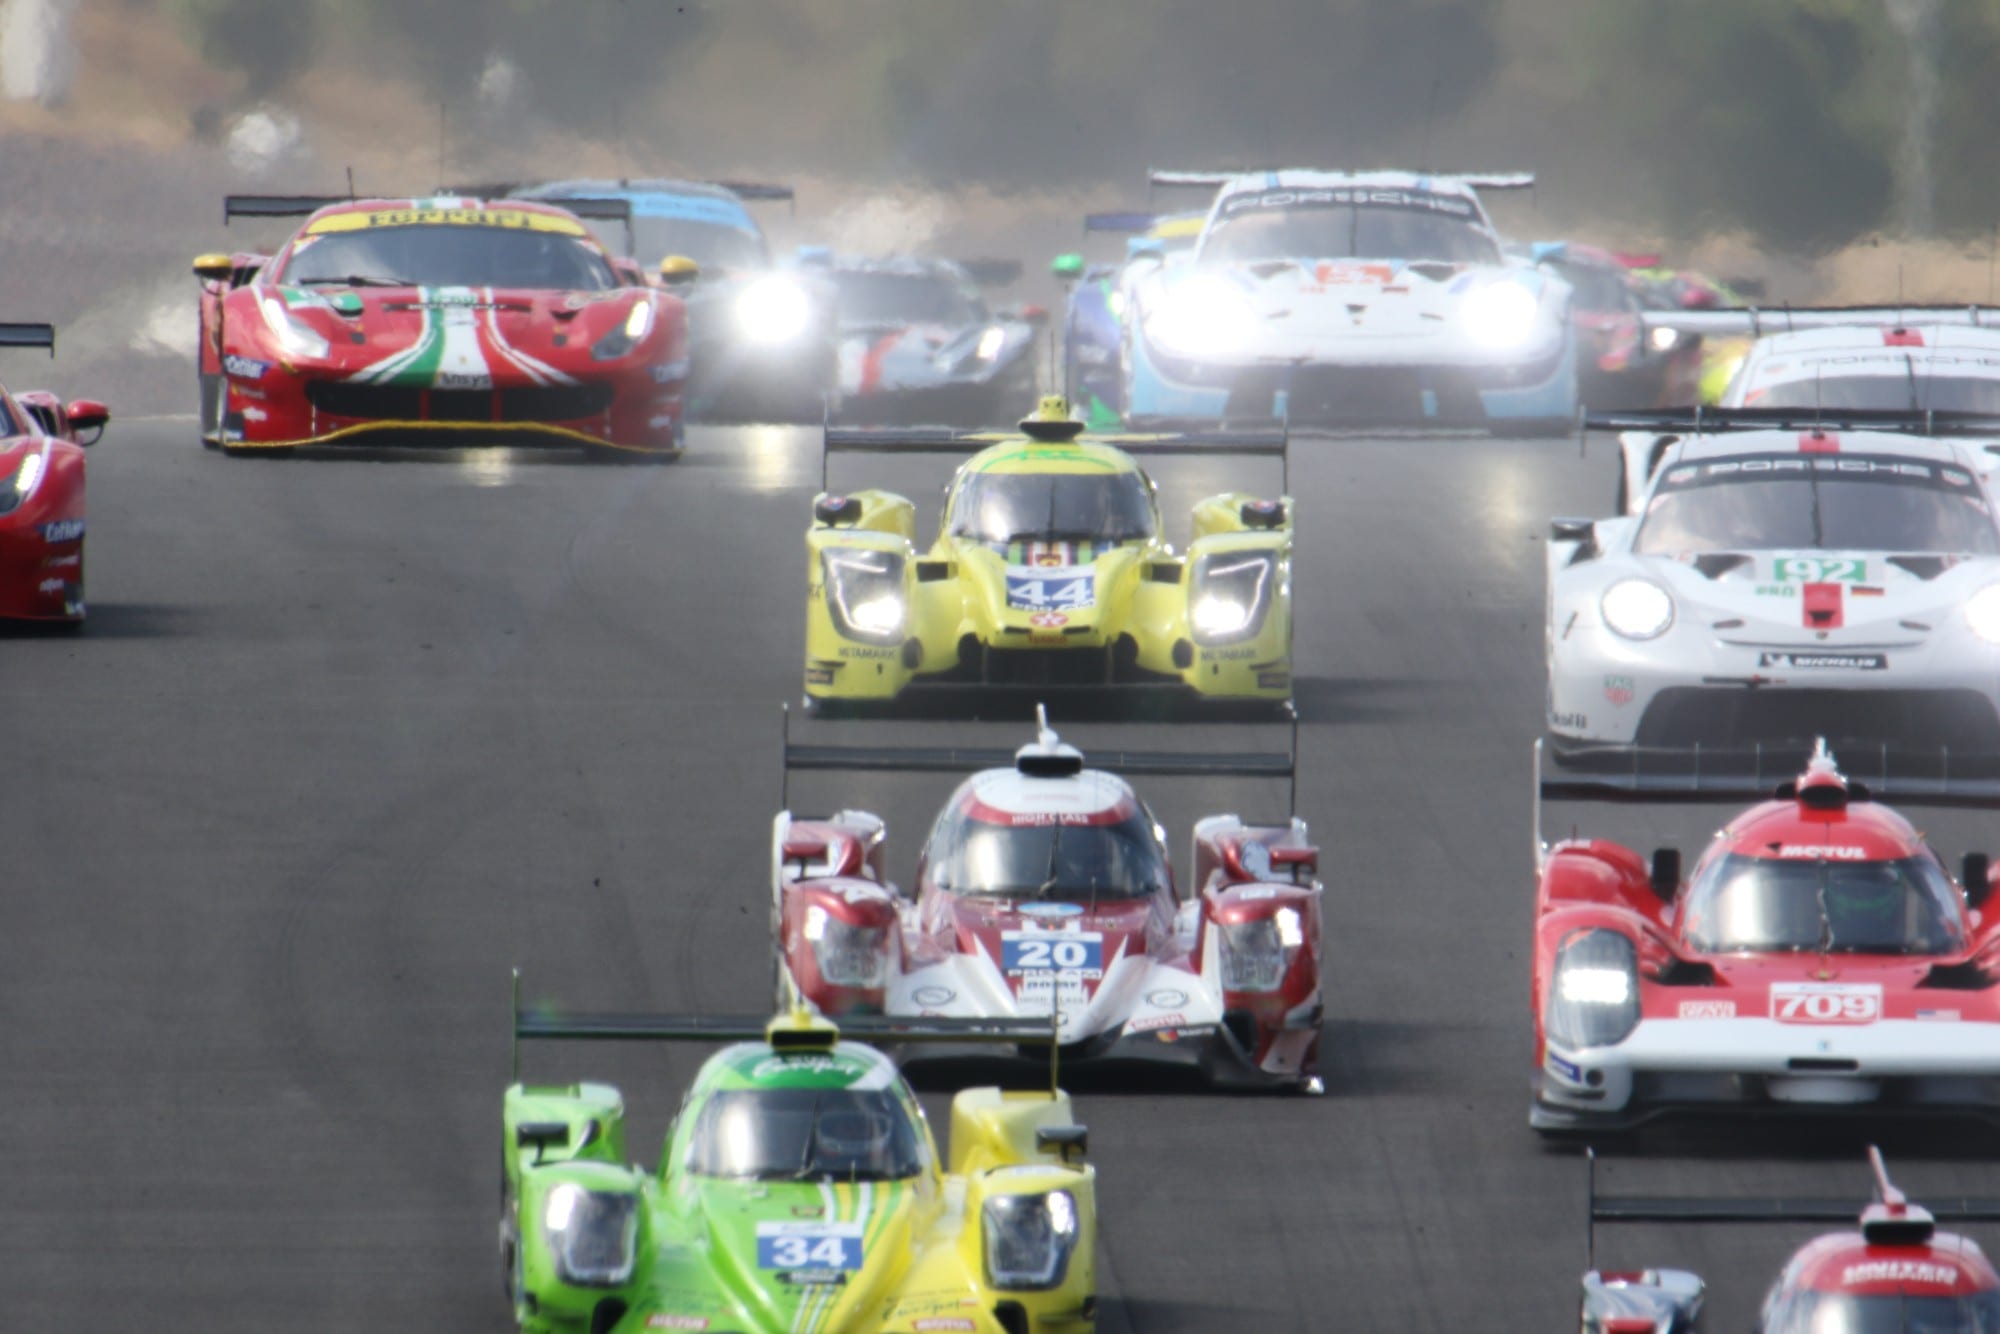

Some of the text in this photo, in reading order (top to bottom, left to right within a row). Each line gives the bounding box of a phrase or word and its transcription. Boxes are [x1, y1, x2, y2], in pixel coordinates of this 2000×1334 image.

[1227, 191, 1470, 214] PORSCHE
[1709, 460, 1931, 477] PORSCHE
[1784, 558, 1857, 583] 92
[1009, 578, 1096, 604] 44
[1795, 656, 1877, 668] MICHELIN
[1780, 845, 1867, 859] MOTUL
[1017, 941, 1087, 967] 20
[1776, 995, 1879, 1018] 709
[772, 1238, 848, 1267] 34
